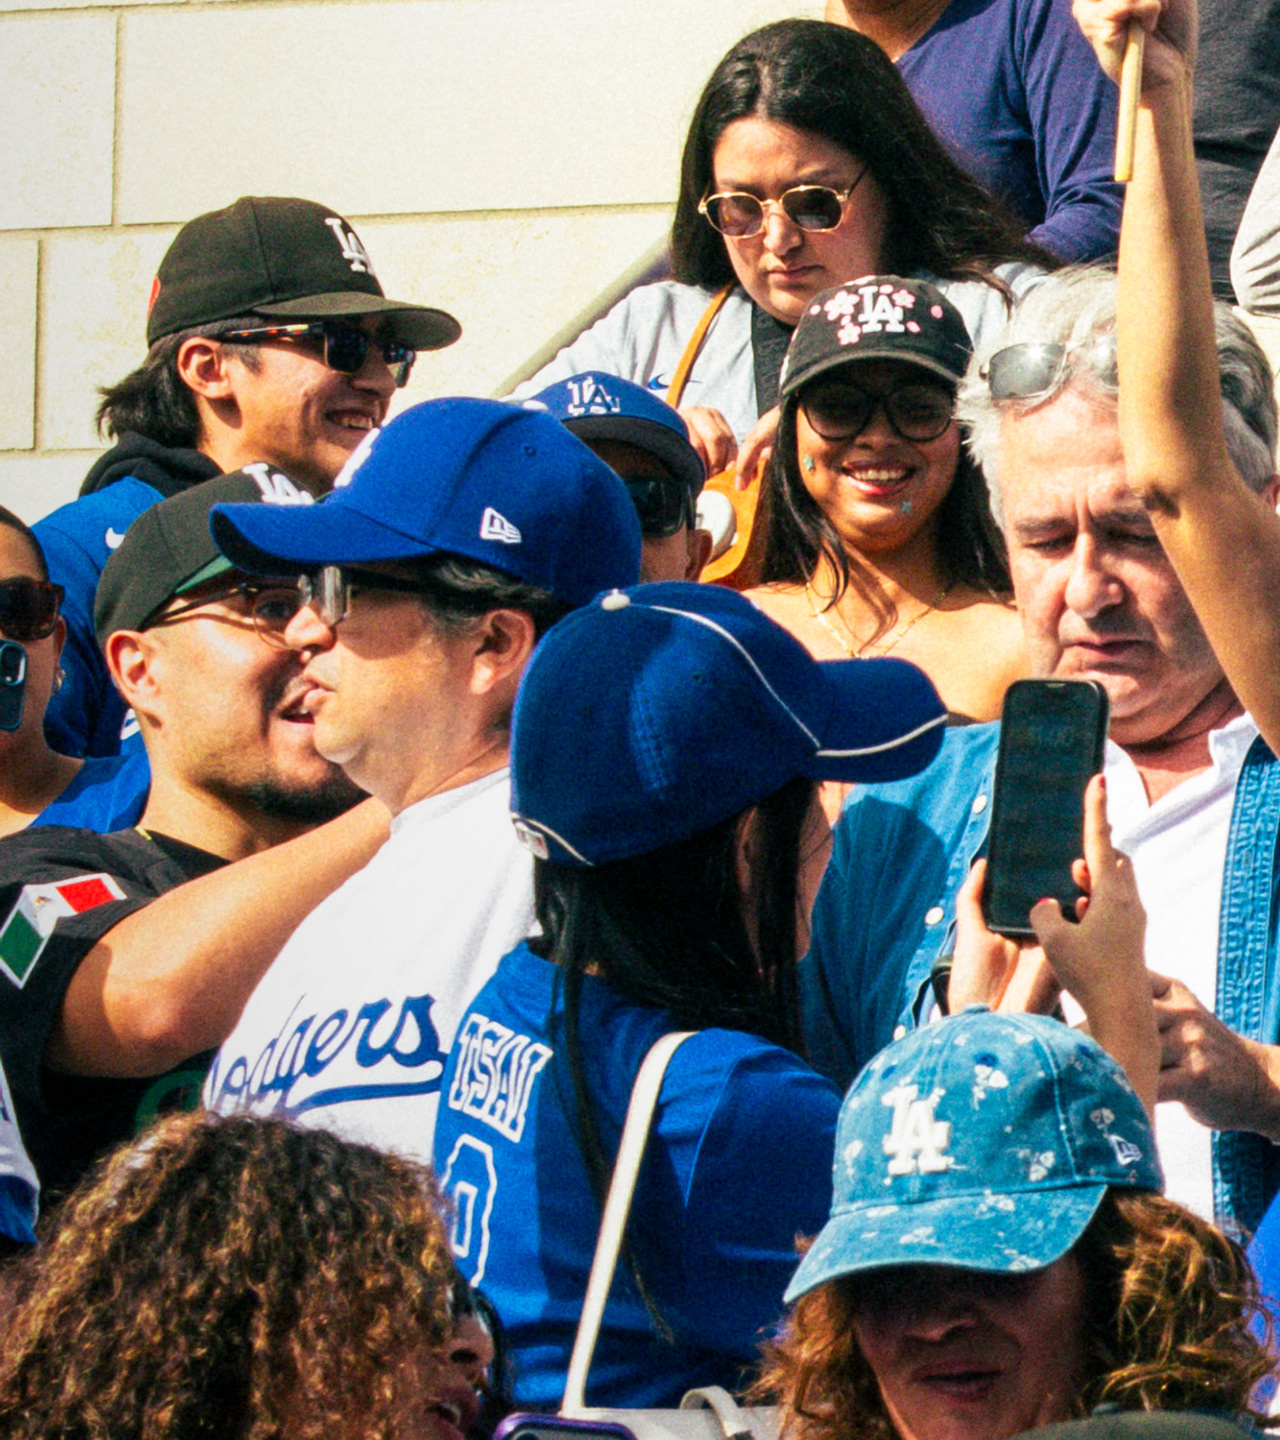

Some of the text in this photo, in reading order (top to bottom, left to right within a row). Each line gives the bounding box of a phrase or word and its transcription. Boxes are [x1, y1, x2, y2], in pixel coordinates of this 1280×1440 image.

[858, 285, 905, 333] LA
[567, 375, 620, 415] LA
[881, 1084, 954, 1175] LA
